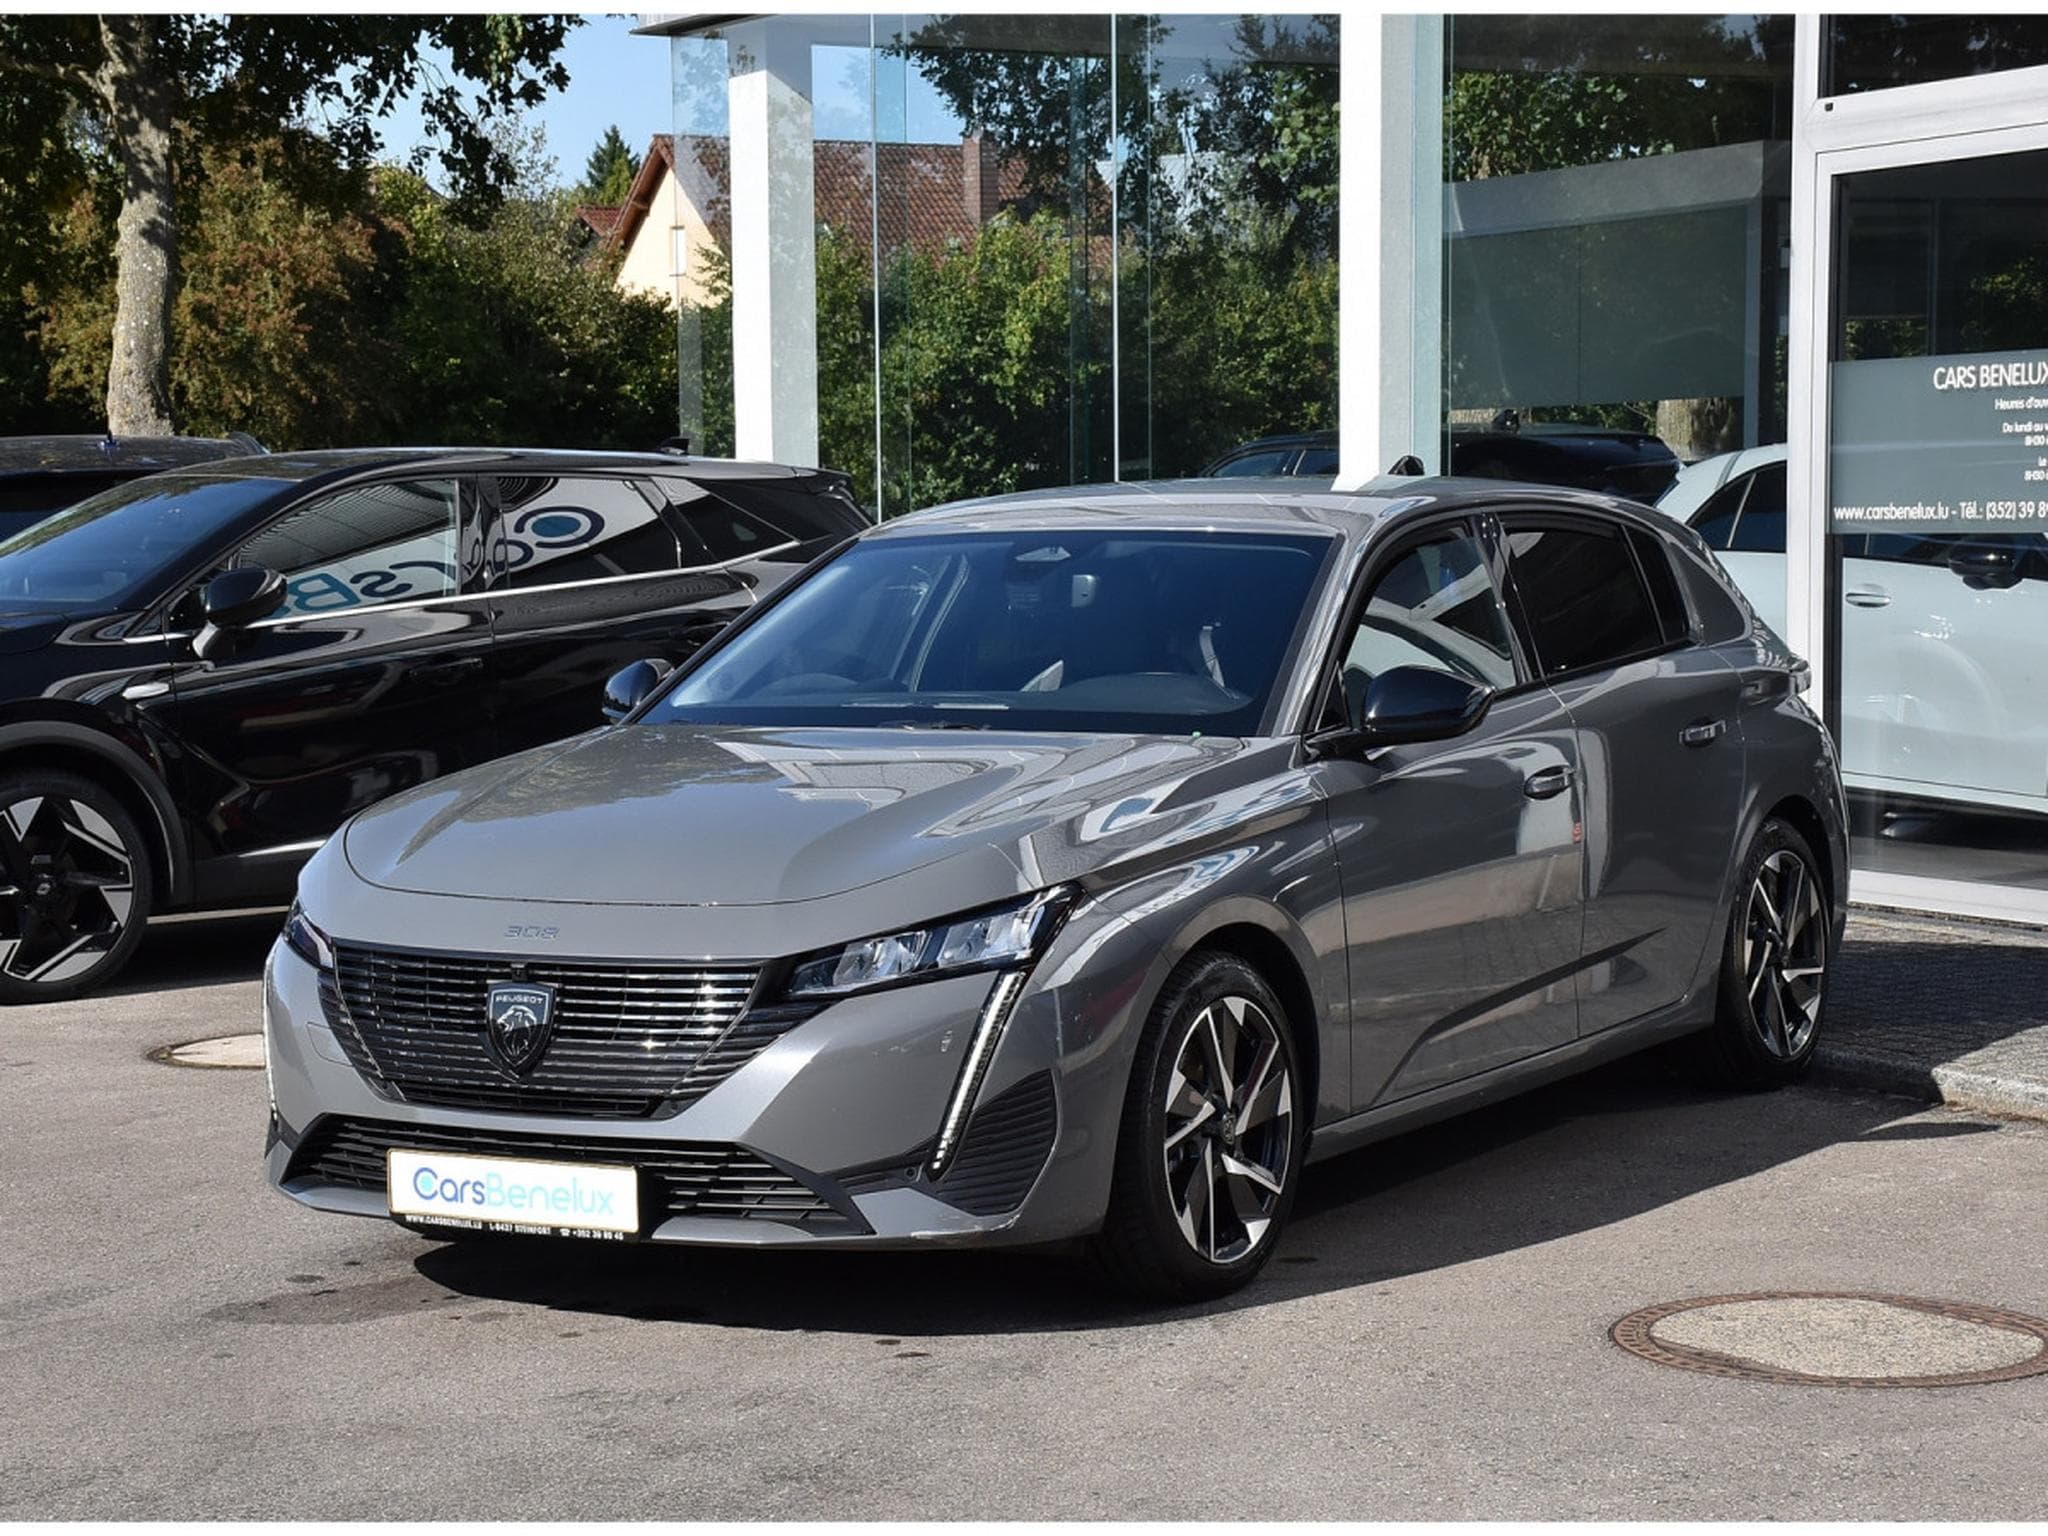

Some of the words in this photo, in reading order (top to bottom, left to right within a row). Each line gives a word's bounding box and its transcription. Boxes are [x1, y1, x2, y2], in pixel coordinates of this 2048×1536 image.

[1933, 365, 1976, 389] CARS
[1834, 502, 1949, 520] www.carsbenelux.lu
[1986, 501, 2017, 521] (352)
[2018, 501, 2035, 519] 39
[2038, 501, 2048, 519] 8
[504, 926, 560, 939] 308
[495, 994, 544, 1004] PEUGEOT
[413, 1167, 614, 1215] CarsBenelux
